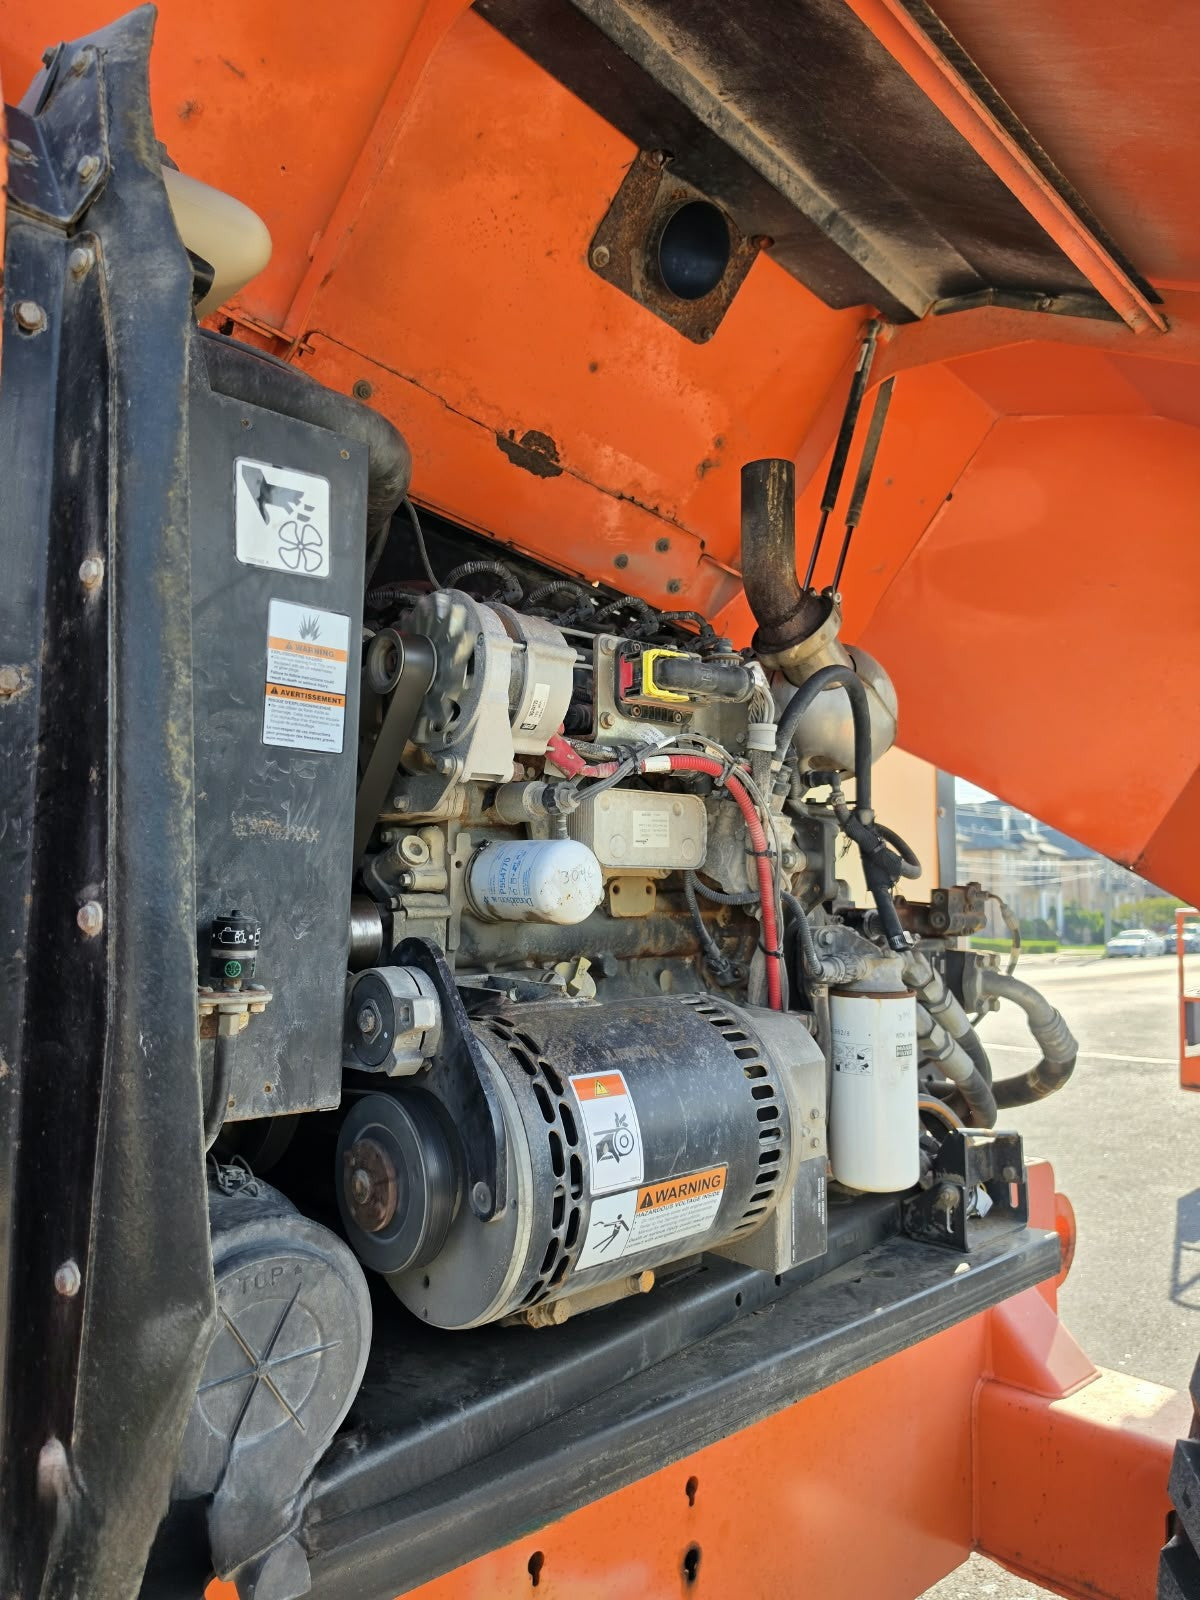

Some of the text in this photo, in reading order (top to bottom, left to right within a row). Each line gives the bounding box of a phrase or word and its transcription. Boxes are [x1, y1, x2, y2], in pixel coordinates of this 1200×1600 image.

[295, 644, 335, 658] WARNING
[280, 689, 342, 705] AVERTISSEMENT
[655, 1174, 721, 1204] WARNING
[238, 1266, 283, 1293] TOP
